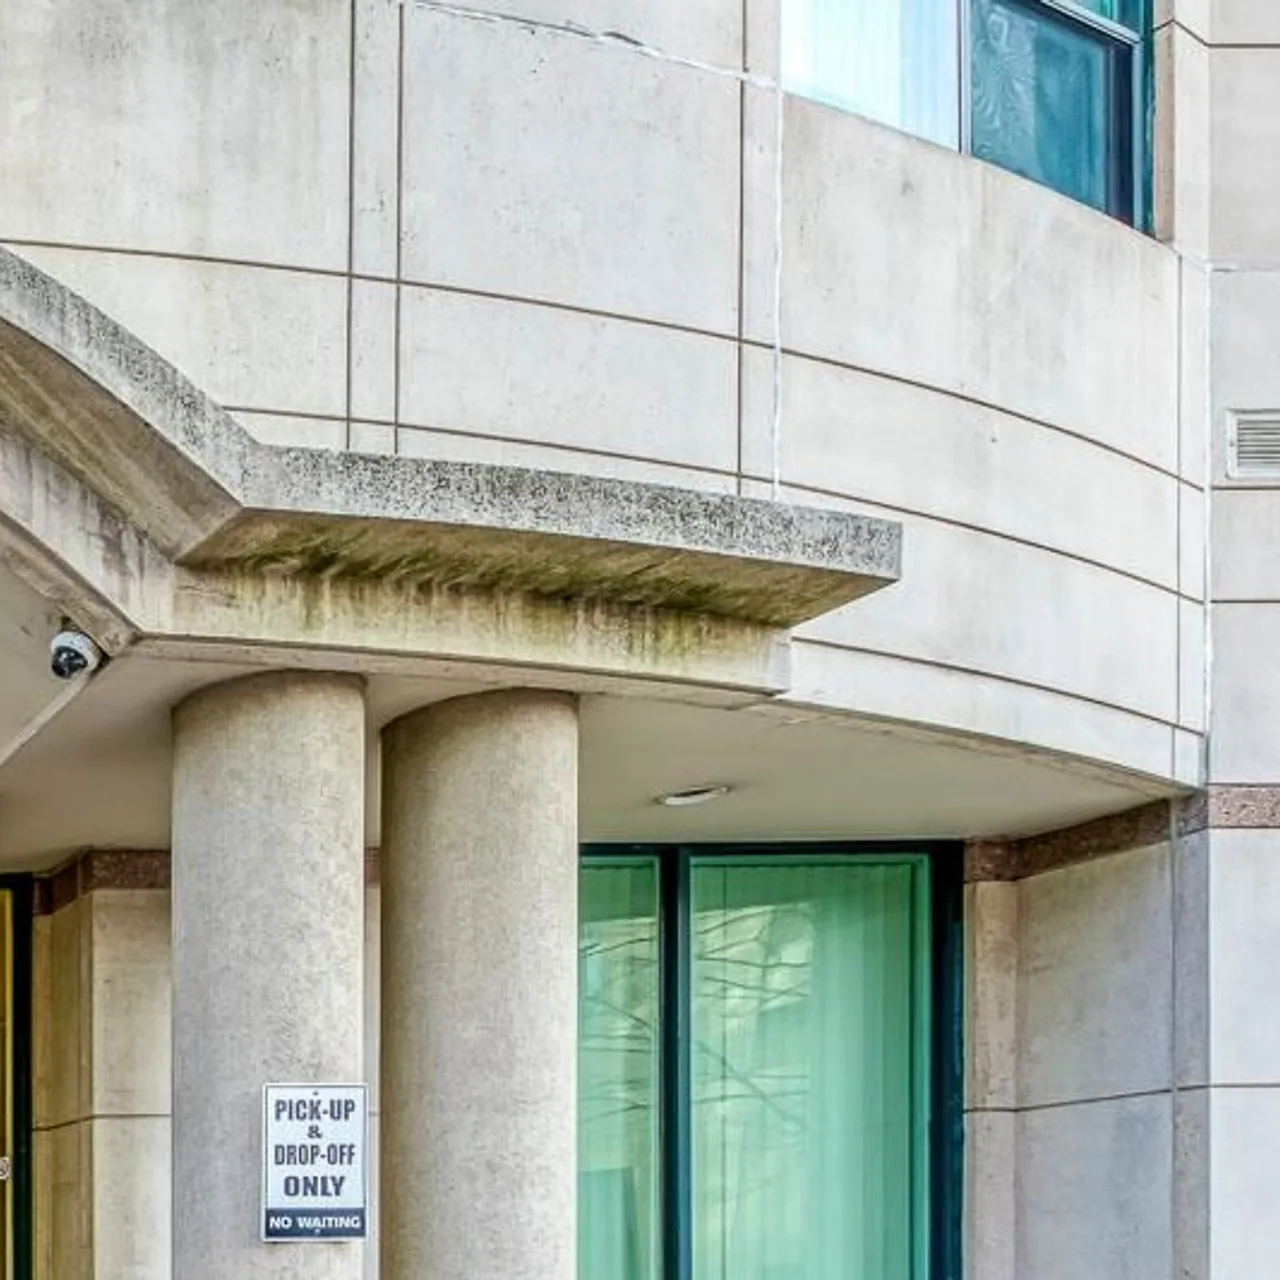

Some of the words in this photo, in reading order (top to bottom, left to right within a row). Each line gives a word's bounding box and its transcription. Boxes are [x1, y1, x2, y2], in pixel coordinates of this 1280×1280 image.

[274, 1099, 356, 1121] PICK-UP
[307, 1125, 322, 1139] &
[274, 1144, 356, 1165] DROP-OFF
[283, 1176, 345, 1196] ONLY
[269, 1217, 292, 1230] NO
[297, 1216, 362, 1229] WAITING
